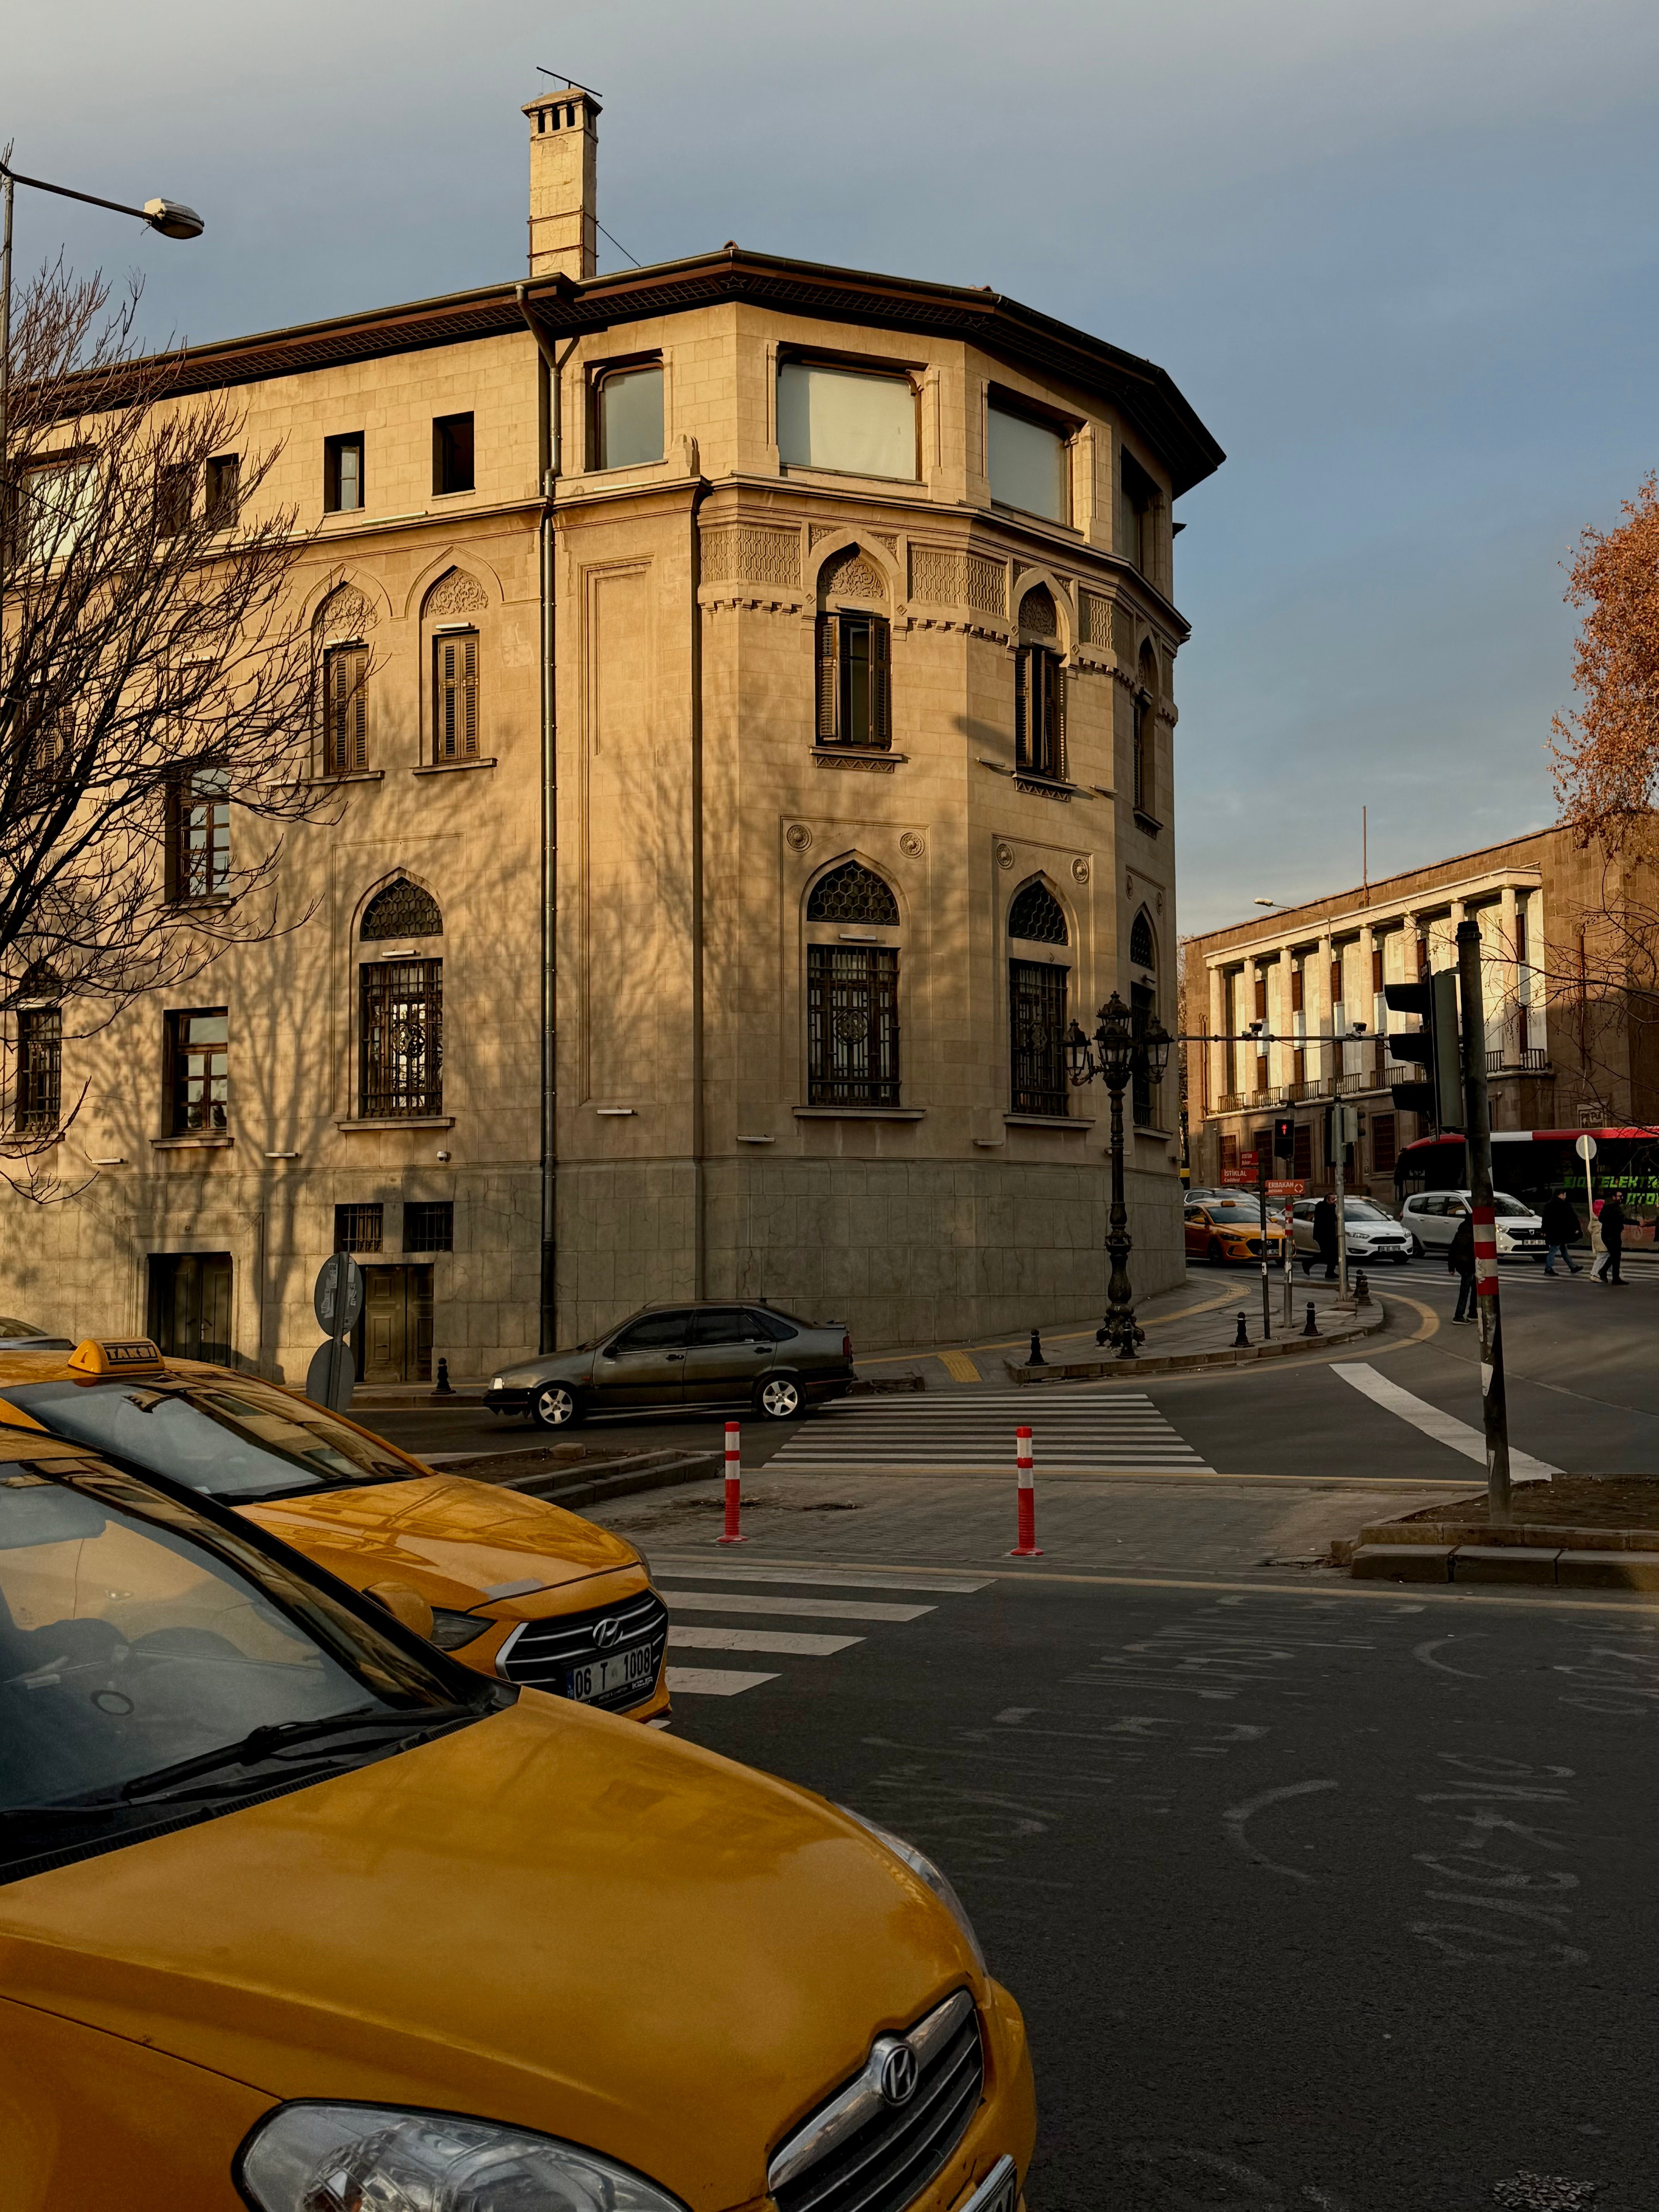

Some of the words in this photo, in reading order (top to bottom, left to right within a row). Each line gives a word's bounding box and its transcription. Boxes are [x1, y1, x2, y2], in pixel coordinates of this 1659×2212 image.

[575, 1668, 591, 1698] 06
[601, 1662, 608, 1690] T
[624, 1647, 650, 1681] 1008
